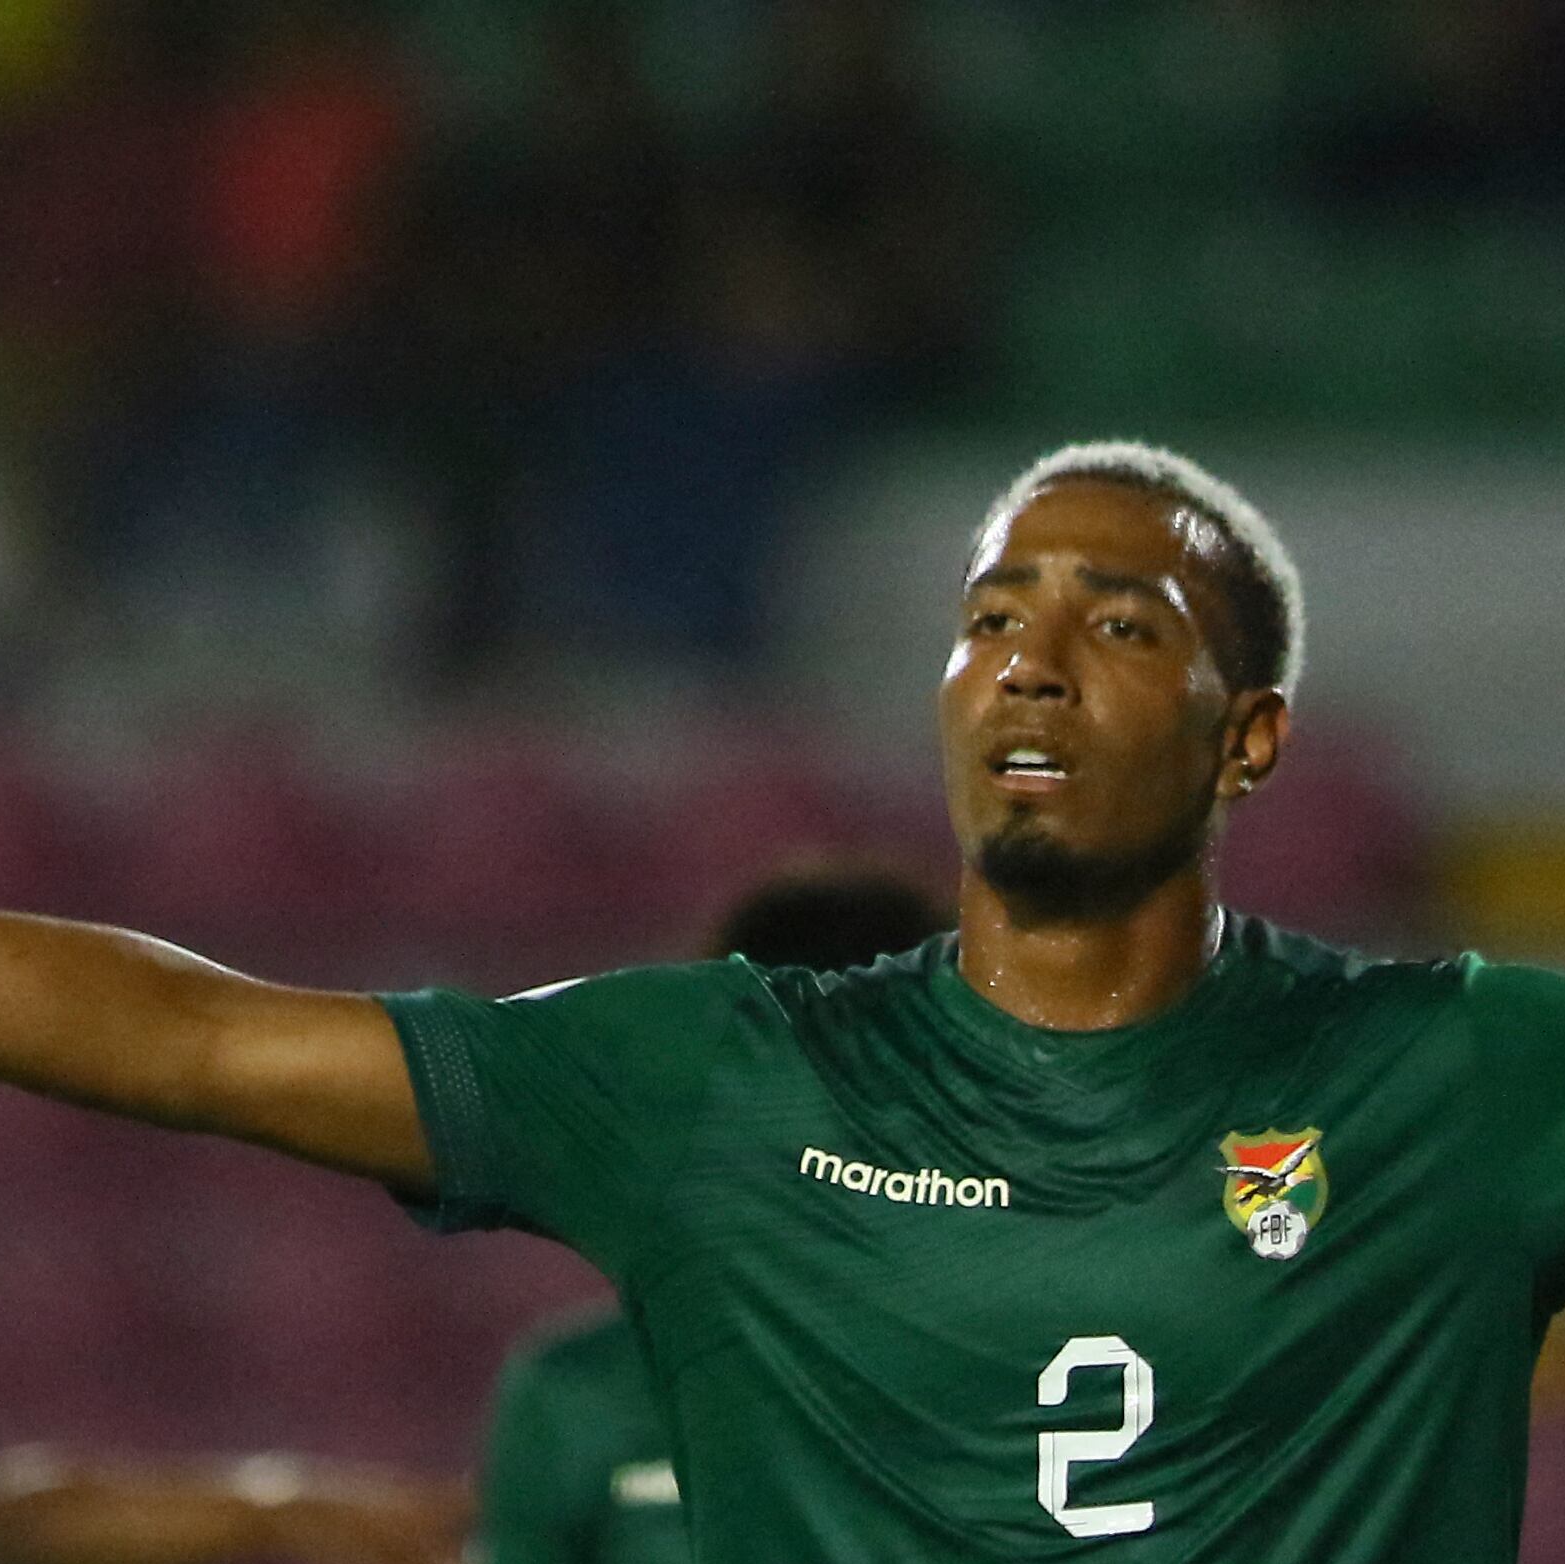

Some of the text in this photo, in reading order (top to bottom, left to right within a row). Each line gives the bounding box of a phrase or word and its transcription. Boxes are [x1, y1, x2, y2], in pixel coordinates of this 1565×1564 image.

[799, 1146, 1010, 1208] marathon
[1259, 1213, 1292, 1245] FBF
[1037, 1335, 1155, 1539] 2
